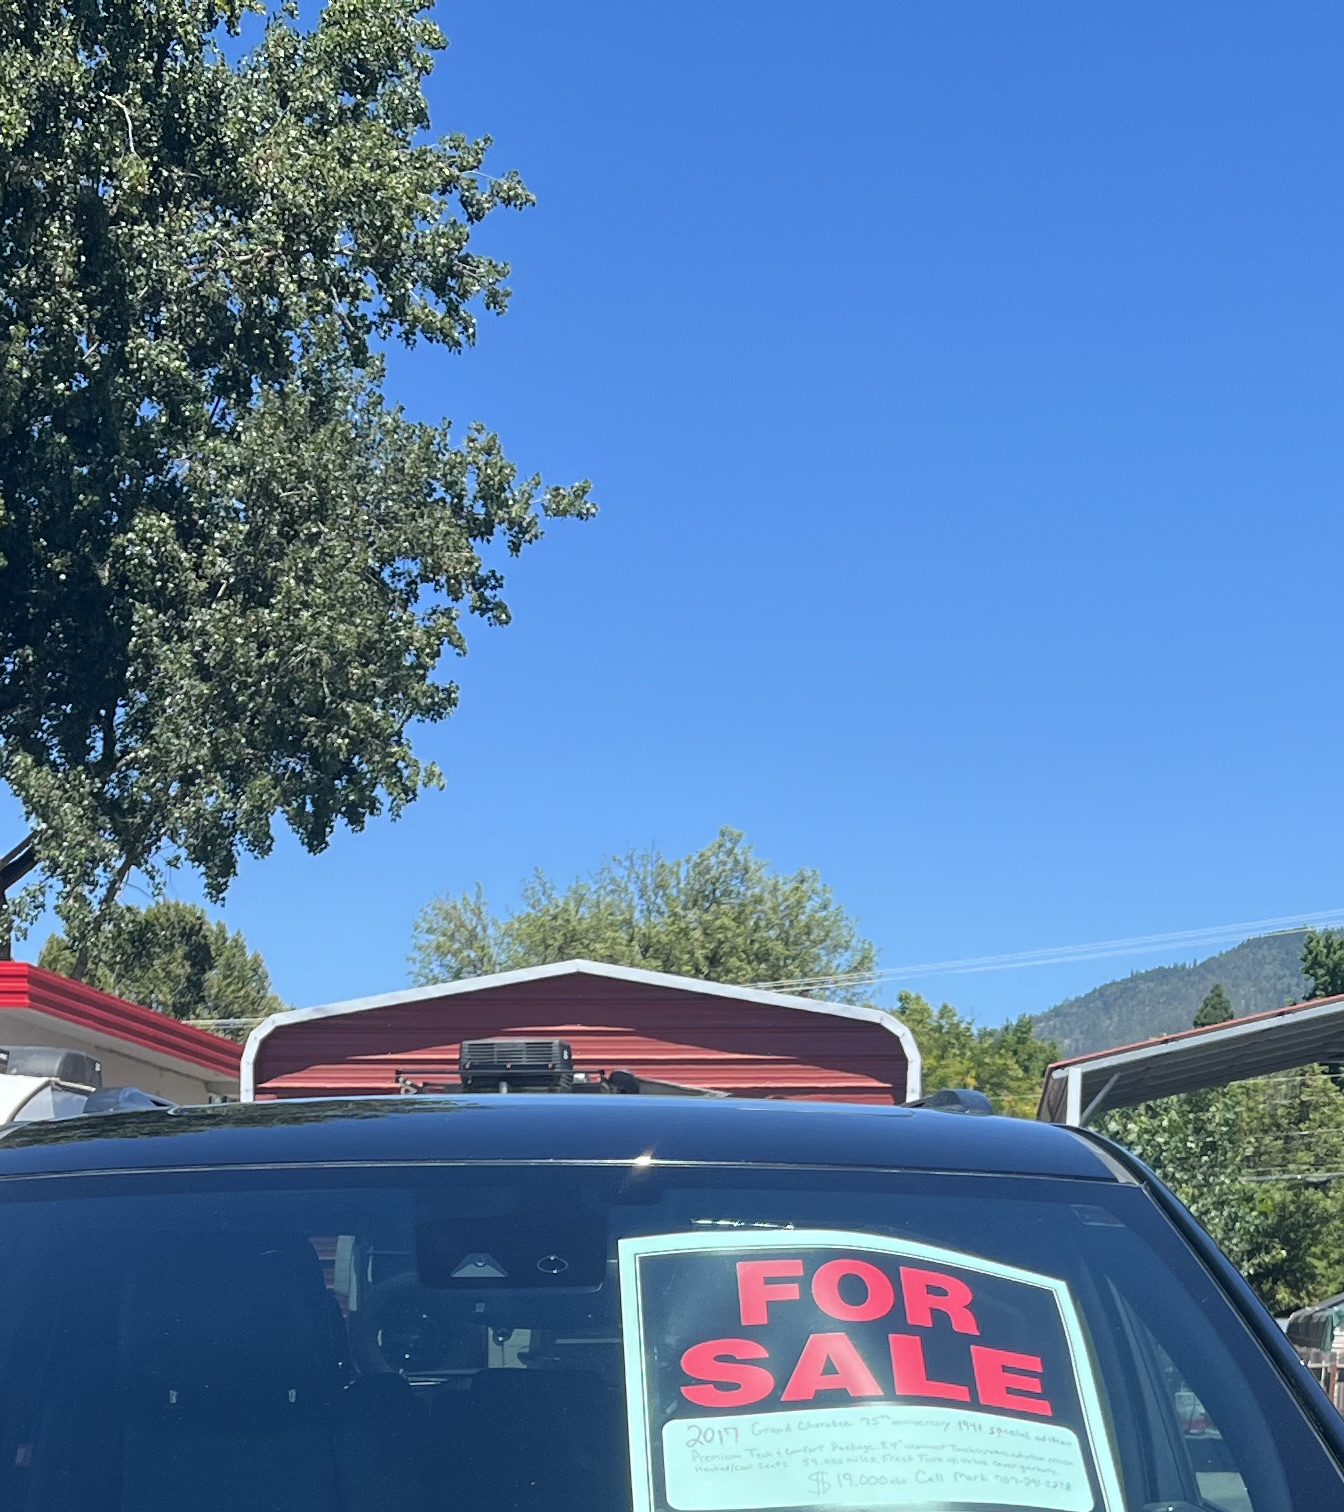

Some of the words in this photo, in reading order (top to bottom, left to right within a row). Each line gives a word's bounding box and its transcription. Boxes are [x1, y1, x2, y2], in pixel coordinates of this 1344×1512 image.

[736, 1259, 979, 1335] FOR
[680, 1332, 1052, 1416] SALE
[686, 1424, 739, 1448] 2017
[751, 1421, 792, 1436] Grand
[798, 1418, 854, 1431] Cherokee
[958, 1419, 982, 1432] 1941
[691, 1448, 742, 1463] Premium
[745, 1448, 772, 1459] Tech
[915, 1469, 944, 1484] Call
[953, 1471, 989, 1483] Mark
